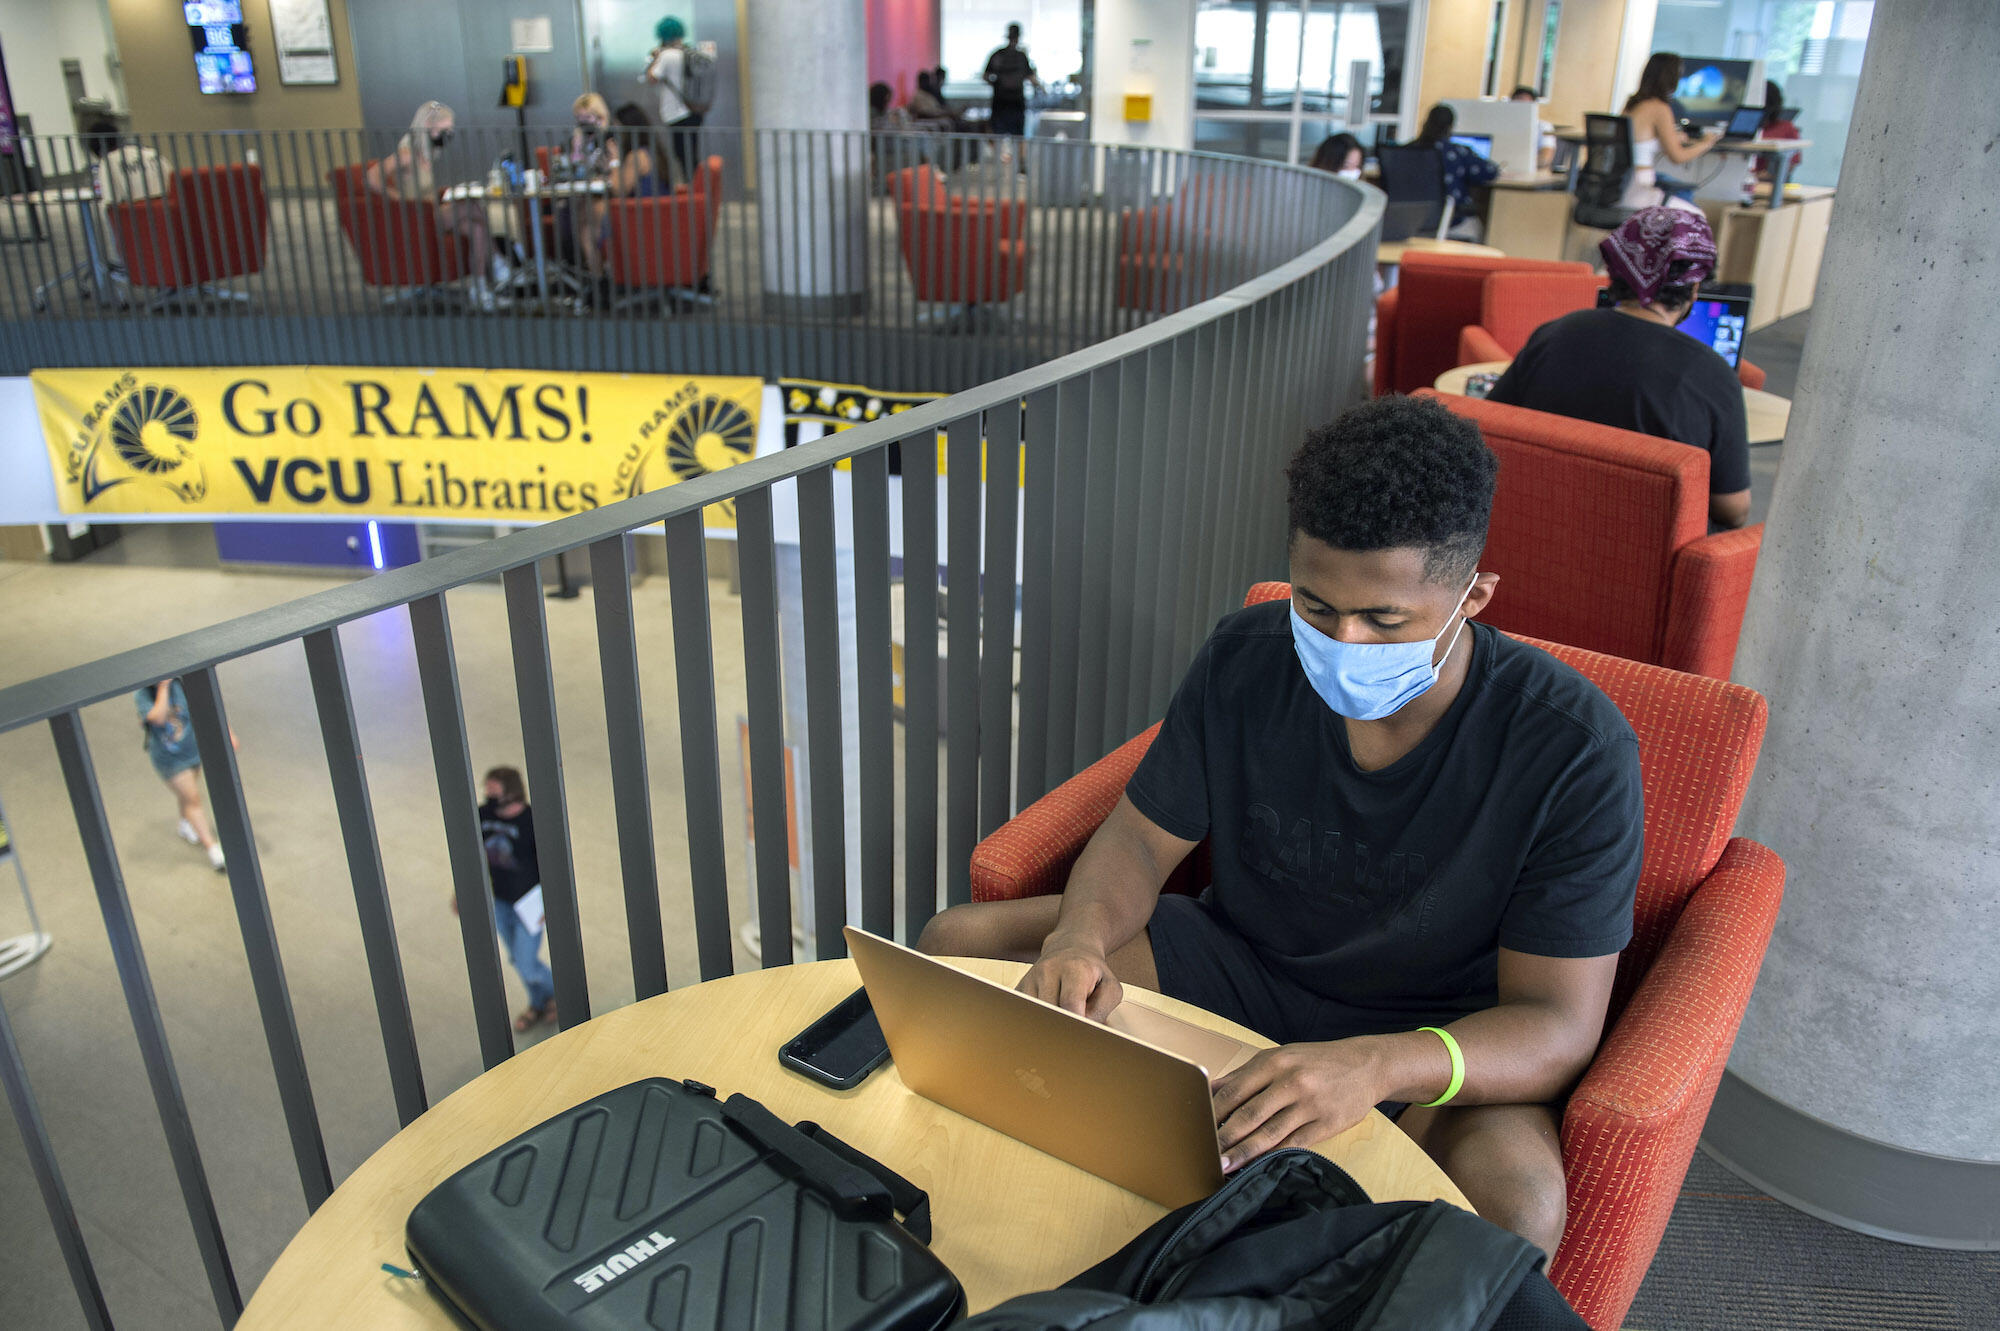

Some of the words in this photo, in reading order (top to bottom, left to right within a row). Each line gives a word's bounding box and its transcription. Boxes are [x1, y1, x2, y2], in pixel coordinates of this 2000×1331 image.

[67, 430, 91, 485] VCU
[82, 372, 138, 430] RAMS
[221, 379, 323, 438] Go
[344, 379, 594, 444] RAMS!
[612, 443, 642, 496] VCU
[639, 381, 699, 439] RAMS
[232, 457, 372, 506] VCU
[386, 460, 600, 513] Libraries
[573, 1231, 677, 1294] THULE
